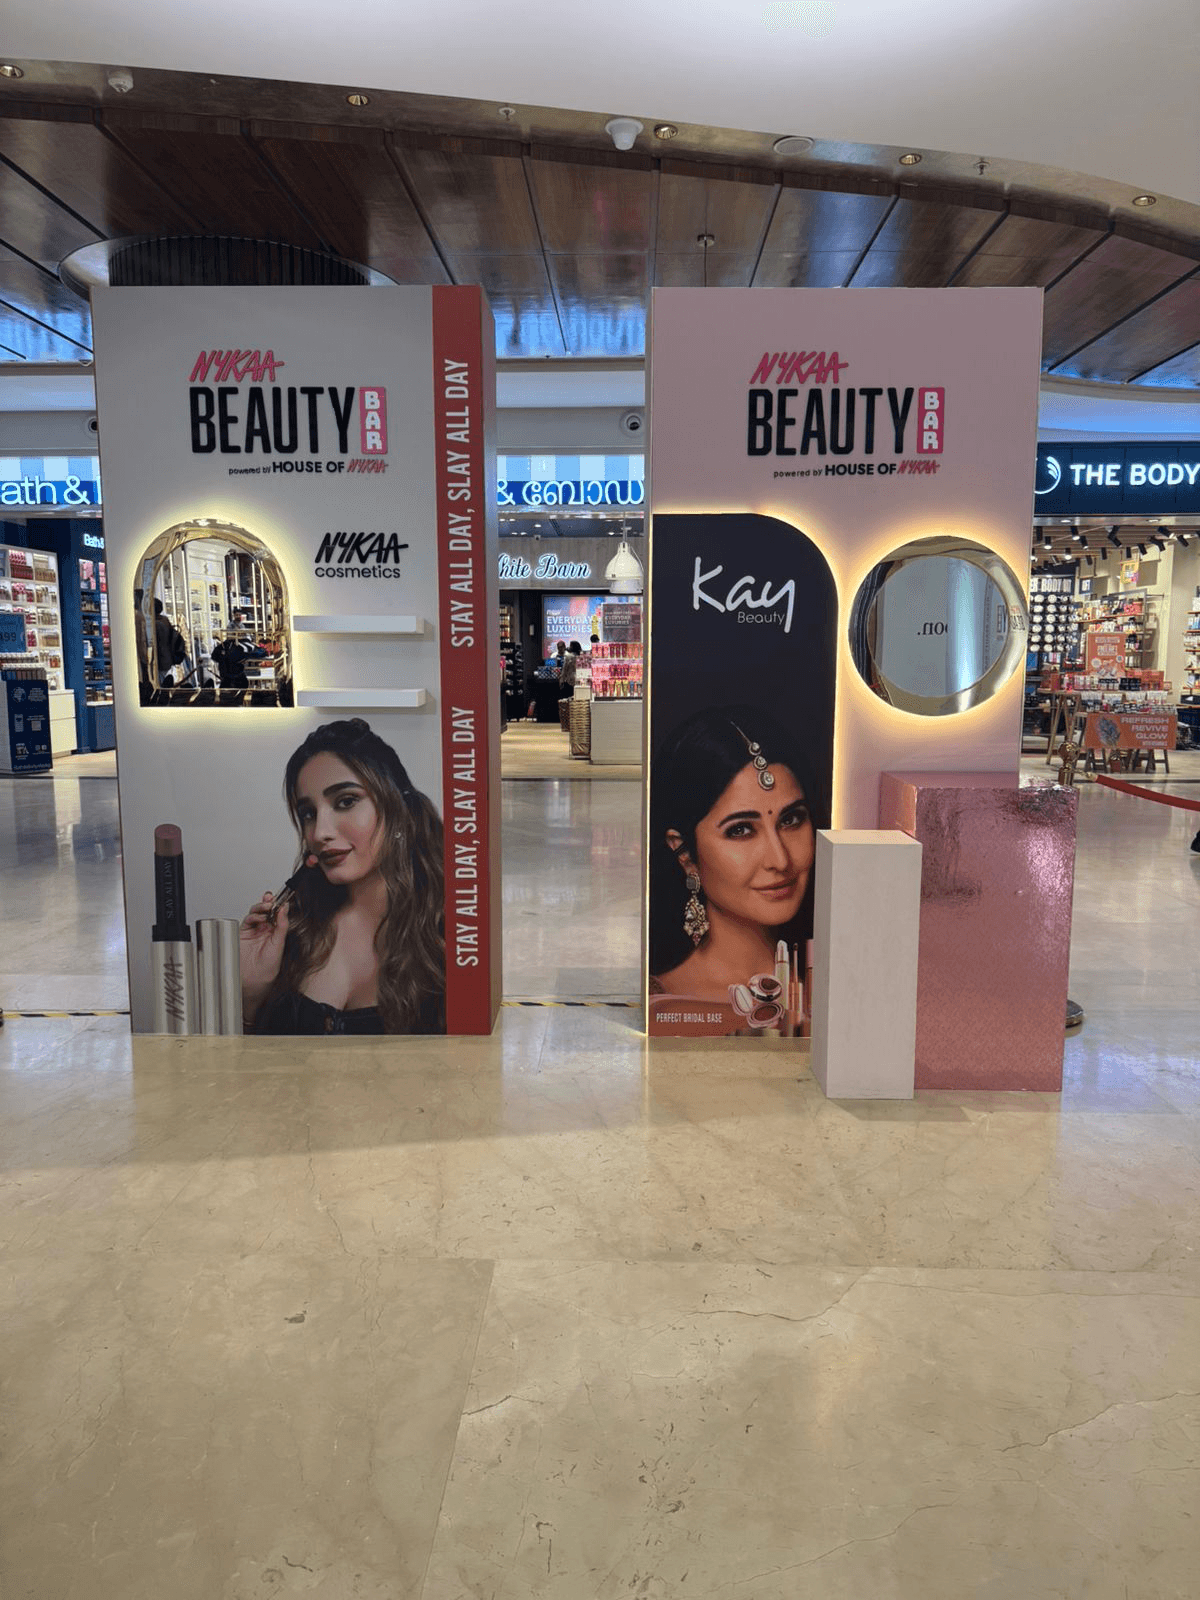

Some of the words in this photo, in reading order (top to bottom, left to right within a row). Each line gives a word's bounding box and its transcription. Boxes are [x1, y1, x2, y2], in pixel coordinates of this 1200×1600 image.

[188, 350, 284, 382] NYKAA
[444, 359, 469, 398] DAY
[748, 351, 849, 384] NYKAA
[190, 386, 355, 454] BEAUTY
[364, 391, 382, 450] BAR
[446, 406, 470, 443] ALL
[748, 387, 914, 456] BEAUTY
[922, 392, 940, 450] BAR
[228, 466, 261, 476] powered
[272, 461, 322, 473] HOUSE
[326, 461, 345, 473] OF
[347, 459, 388, 474] NYKAA
[447, 450, 471, 500] SLAY
[773, 470, 810, 478] powered
[812, 468, 823, 478] by
[825, 464, 874, 476] HOUSE
[877, 463, 897, 475] OF
[897, 460, 940, 474] NYKAA
[1070, 464, 1121, 486] THE
[1130, 464, 1200, 486] BODY
[2, 476, 57, 504] ath
[64, 475, 90, 505] &
[522, 480, 644, 506] ബോഡ
[448, 508, 476, 550] DAY,
[315, 532, 409, 564] NYKAA
[315, 565, 400, 578] cosmetics
[450, 558, 473, 593] ALL
[498, 553, 532, 579] hite
[535, 552, 591, 579] Barn
[693, 556, 795, 633] Kay
[450, 600, 474, 648] STAY
[547, 616, 592, 624] EVERYDAY
[547, 625, 592, 633] LUXURIES
[738, 611, 785, 625] Beauty
[452, 706, 475, 742] DAY
[453, 748, 476, 782] ALL
[454, 788, 477, 834] SLAY
[455, 840, 481, 878] DAY,
[456, 884, 478, 917] ALL
[456, 923, 479, 966] STAY
[163, 956, 185, 1021] NYKAA
[656, 1013, 682, 1023] PERFECT
[683, 1013, 705, 1023] BRIDAL
[707, 1013, 723, 1023] BASE
